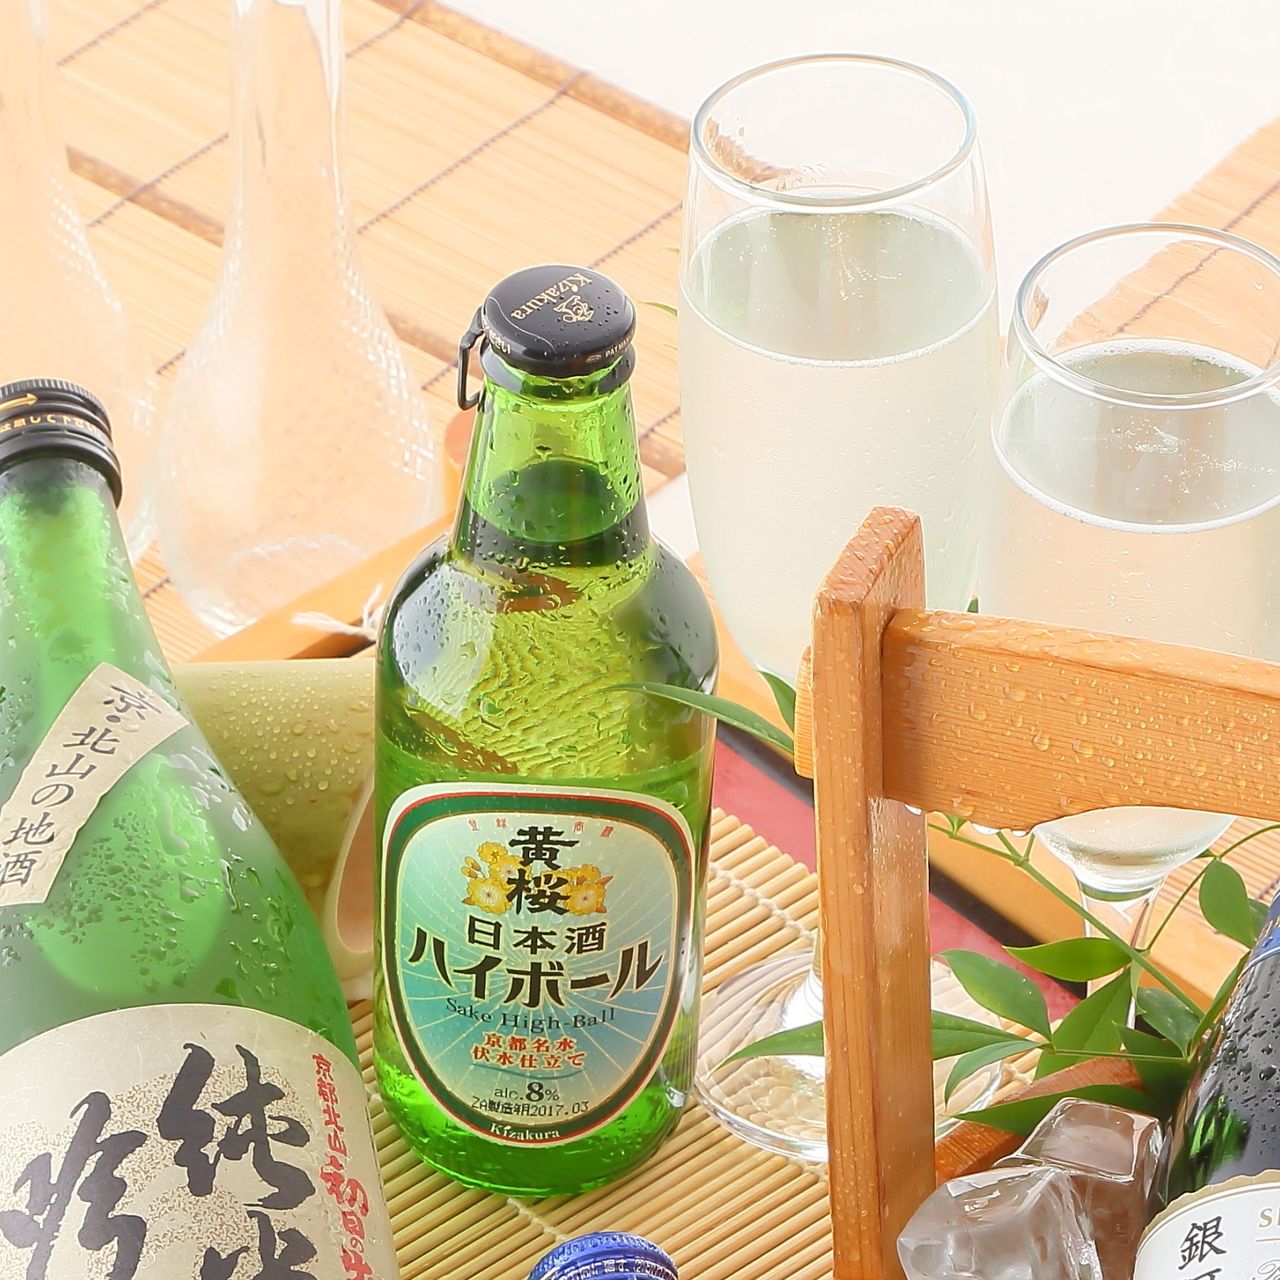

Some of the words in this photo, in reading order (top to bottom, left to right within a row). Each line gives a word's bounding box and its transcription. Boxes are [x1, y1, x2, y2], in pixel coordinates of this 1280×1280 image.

[510, 271, 593, 321] Kizakura
[505, 825, 580, 915] 黄桜
[467, 915, 607, 955] 日本酒
[408, 927, 664, 1008] ハイボール
[446, 998, 493, 1023] Sake
[501, 1008, 617, 1034] High-Ball
[472, 1046, 586, 1069] 伏水仕立て
[484, 1033, 576, 1053] 京都名水
[490, 1122, 561, 1141] Kizakura
